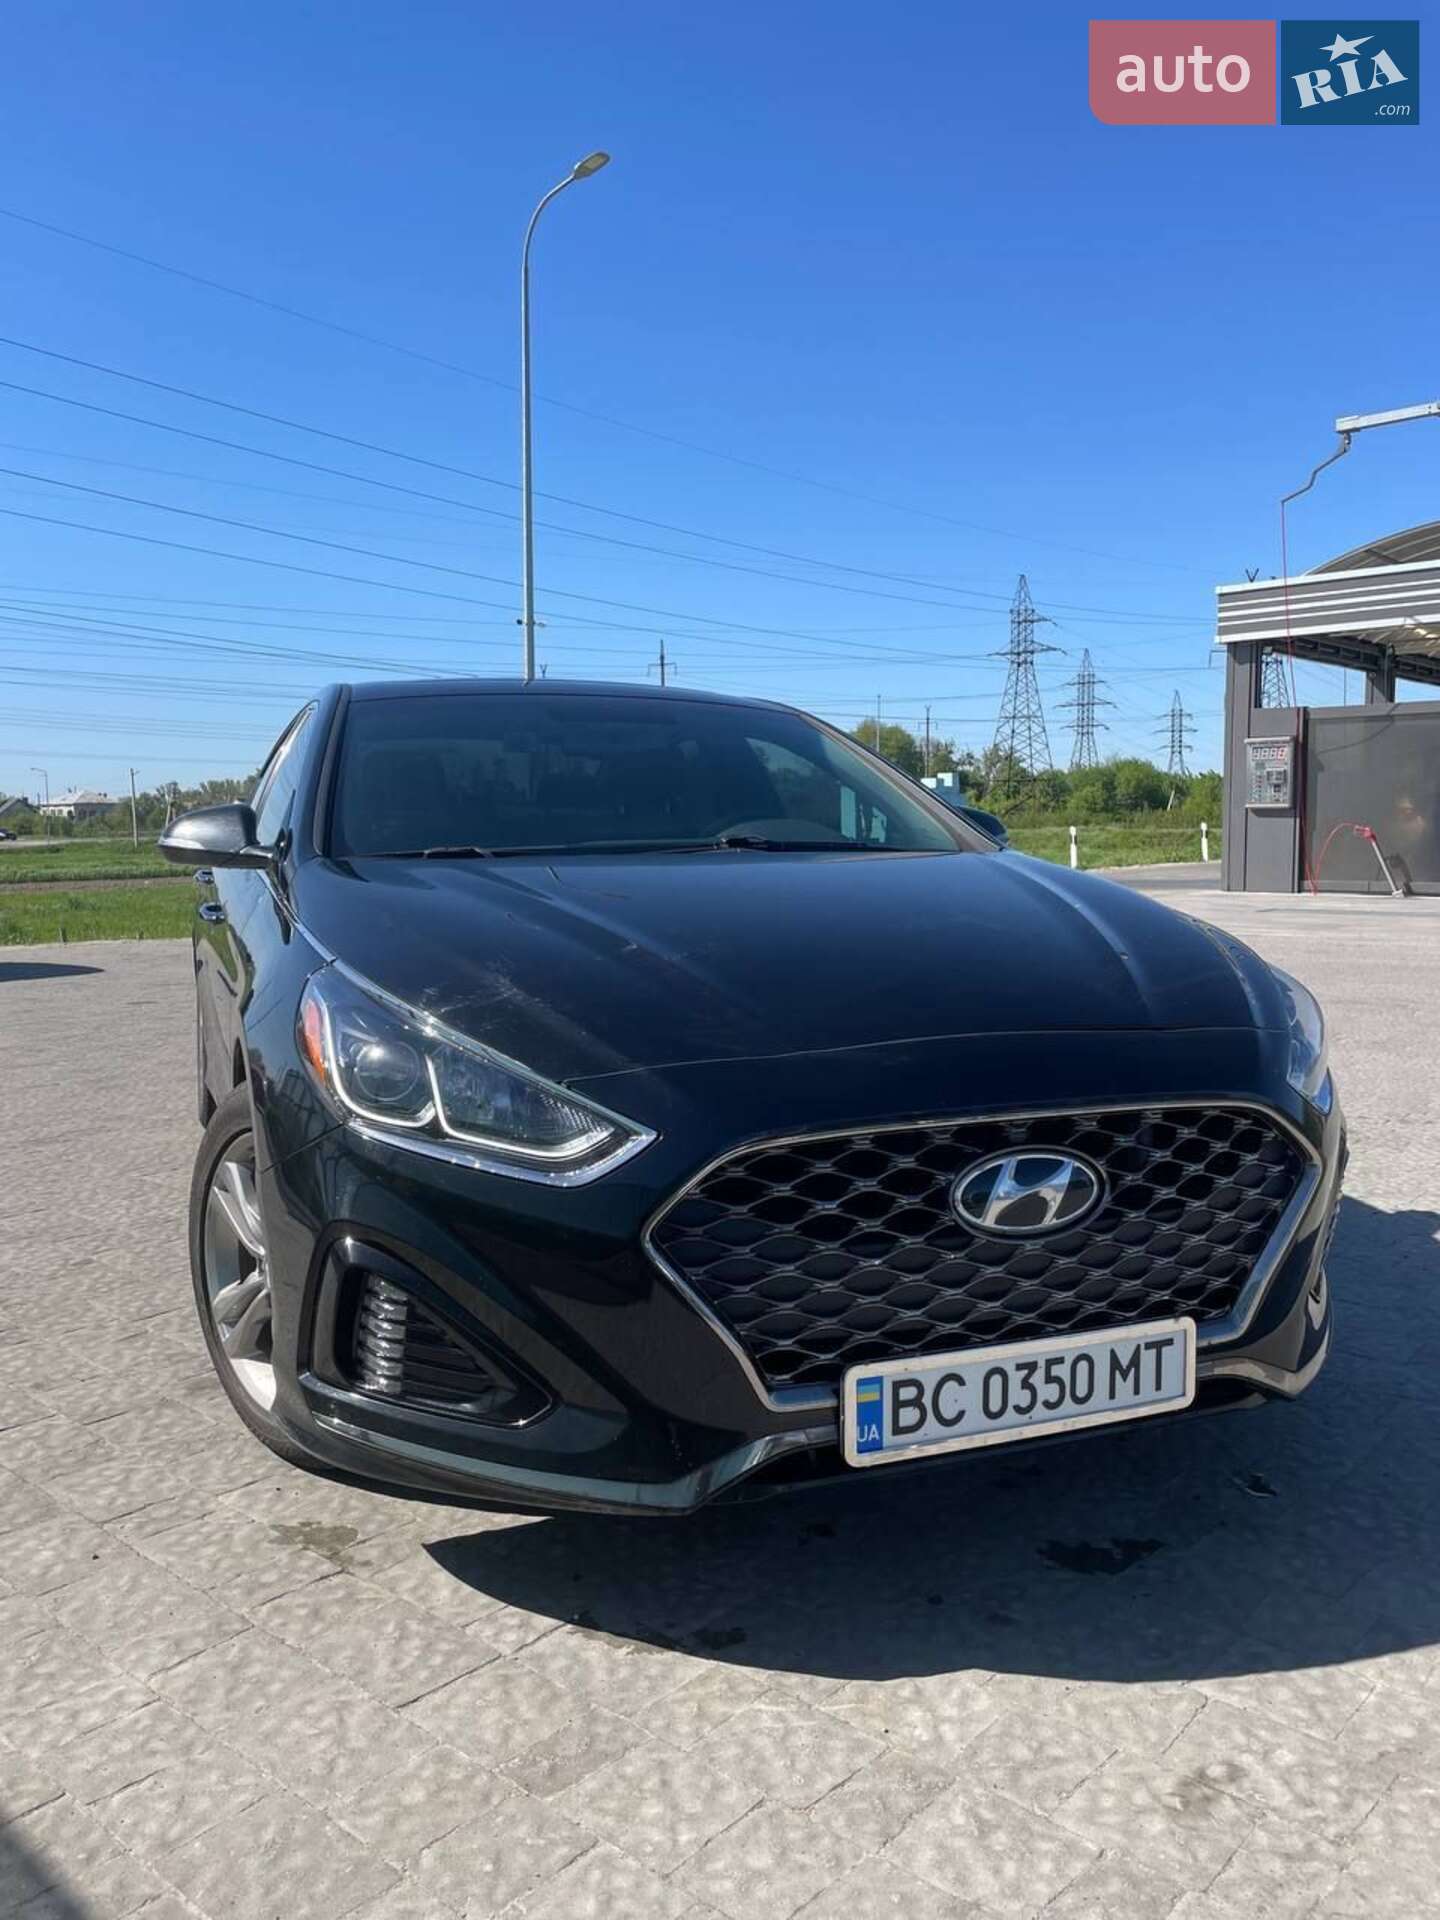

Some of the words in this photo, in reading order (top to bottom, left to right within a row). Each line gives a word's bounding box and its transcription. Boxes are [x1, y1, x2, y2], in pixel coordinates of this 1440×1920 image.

[891, 1373, 967, 1437] BC
[982, 1353, 1095, 1420] 0350
[1108, 1338, 1174, 1400] MT
[857, 1424, 880, 1443] UA
